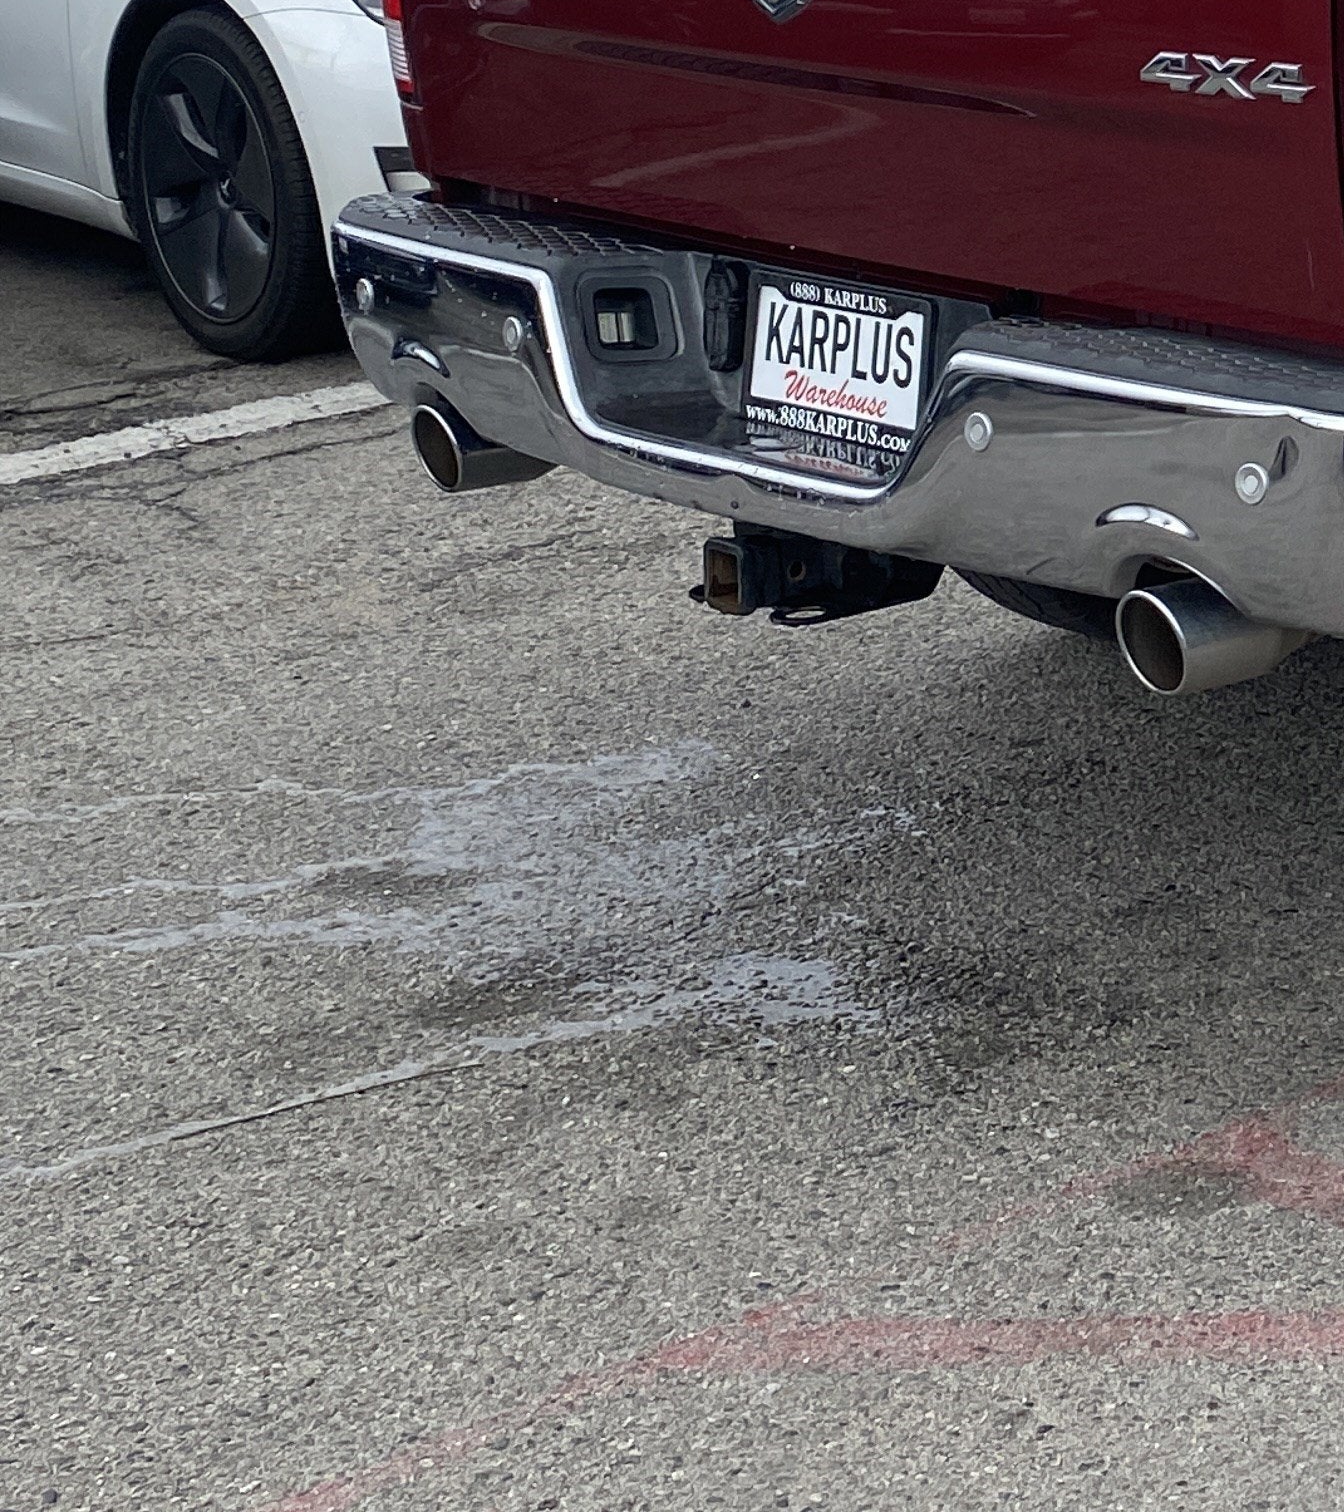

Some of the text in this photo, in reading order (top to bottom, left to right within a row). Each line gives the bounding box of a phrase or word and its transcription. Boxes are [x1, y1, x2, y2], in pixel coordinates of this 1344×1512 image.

[790, 281, 888, 315] (888) KARPLUS
[764, 300, 916, 389] KARPLUS
[784, 369, 888, 419] Warehouse
